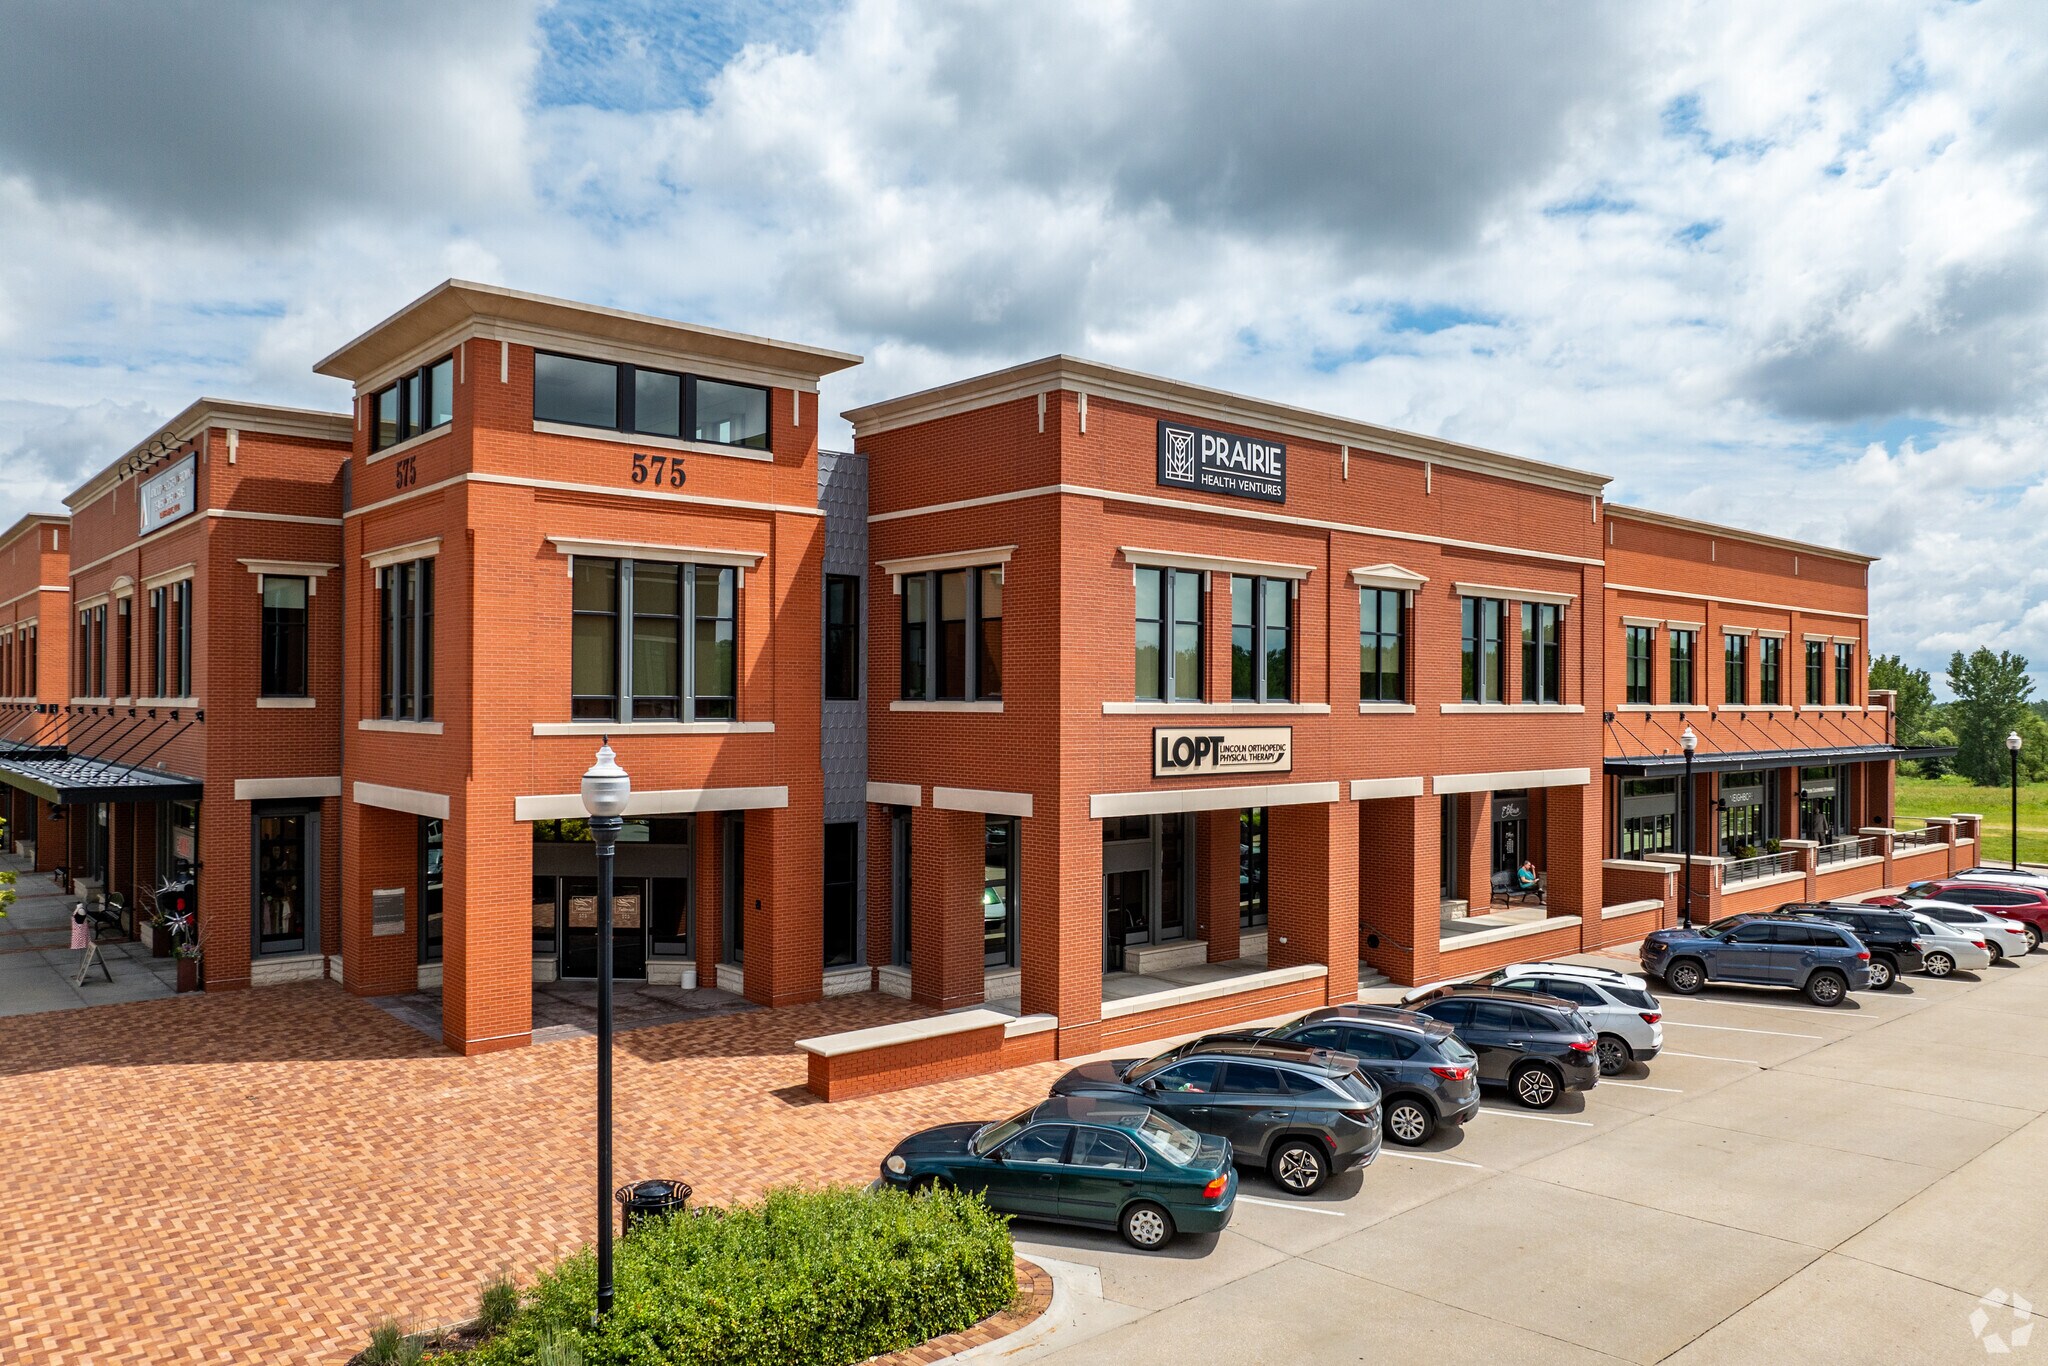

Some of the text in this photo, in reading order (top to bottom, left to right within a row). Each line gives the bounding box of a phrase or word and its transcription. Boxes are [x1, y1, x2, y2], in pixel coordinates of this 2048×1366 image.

[1201, 434, 1281, 475] PRAIRIE
[396, 455, 417, 490] 575
[632, 453, 687, 489] 575
[1201, 474, 1282, 496] HEALTH VENTURES
[1161, 736, 1225, 768] LOPT
[1219, 743, 1287, 754] LINCOLN ORTHOPEDIC
[1219, 752, 1276, 763] PHYSICAL THERAPY
